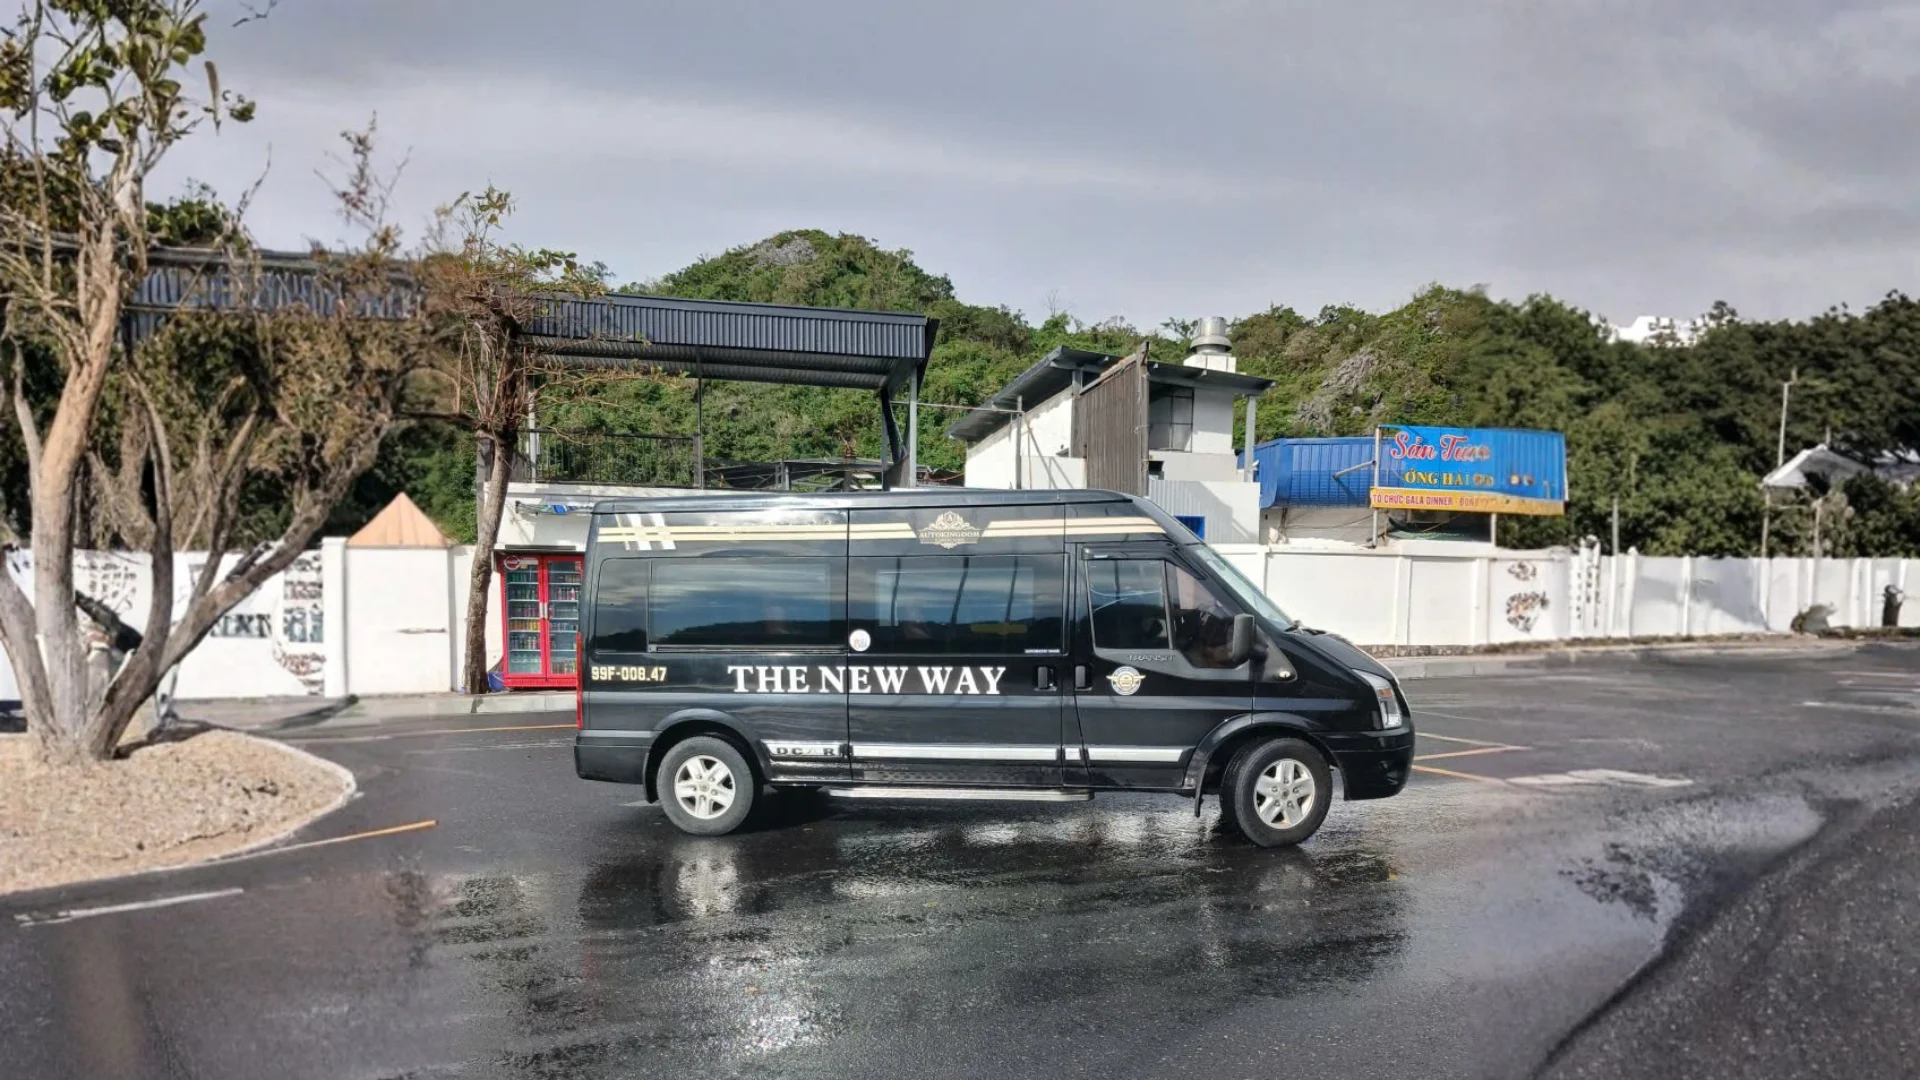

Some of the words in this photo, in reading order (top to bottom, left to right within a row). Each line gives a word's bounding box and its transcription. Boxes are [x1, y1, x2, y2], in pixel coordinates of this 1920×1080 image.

[1405, 496, 1424, 505] GALA
[1426, 496, 1453, 506] DINNER
[591, 666, 667, 681] 99F-008.47
[727, 665, 810, 693] THE
[818, 666, 909, 694] NEW
[917, 666, 1006, 695] WAY
